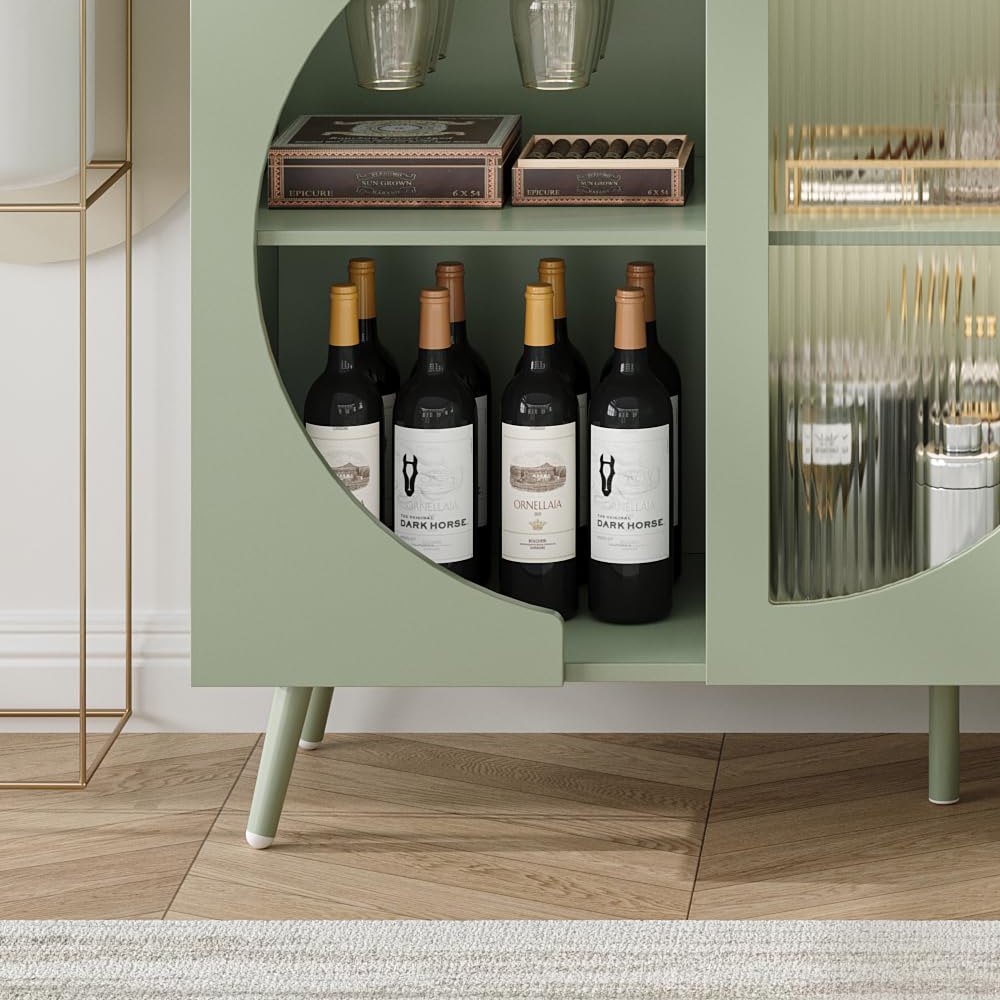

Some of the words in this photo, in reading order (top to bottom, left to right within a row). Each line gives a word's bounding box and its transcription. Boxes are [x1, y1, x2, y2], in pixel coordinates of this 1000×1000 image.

[288, 189, 334, 197] EPICURE
[513, 499, 562, 511] ORNELLAIA
[400, 519, 428, 530] DARK
[430, 518, 468, 530] HORSE
[597, 519, 625, 530] DARK
[627, 518, 664, 530] HORSE
